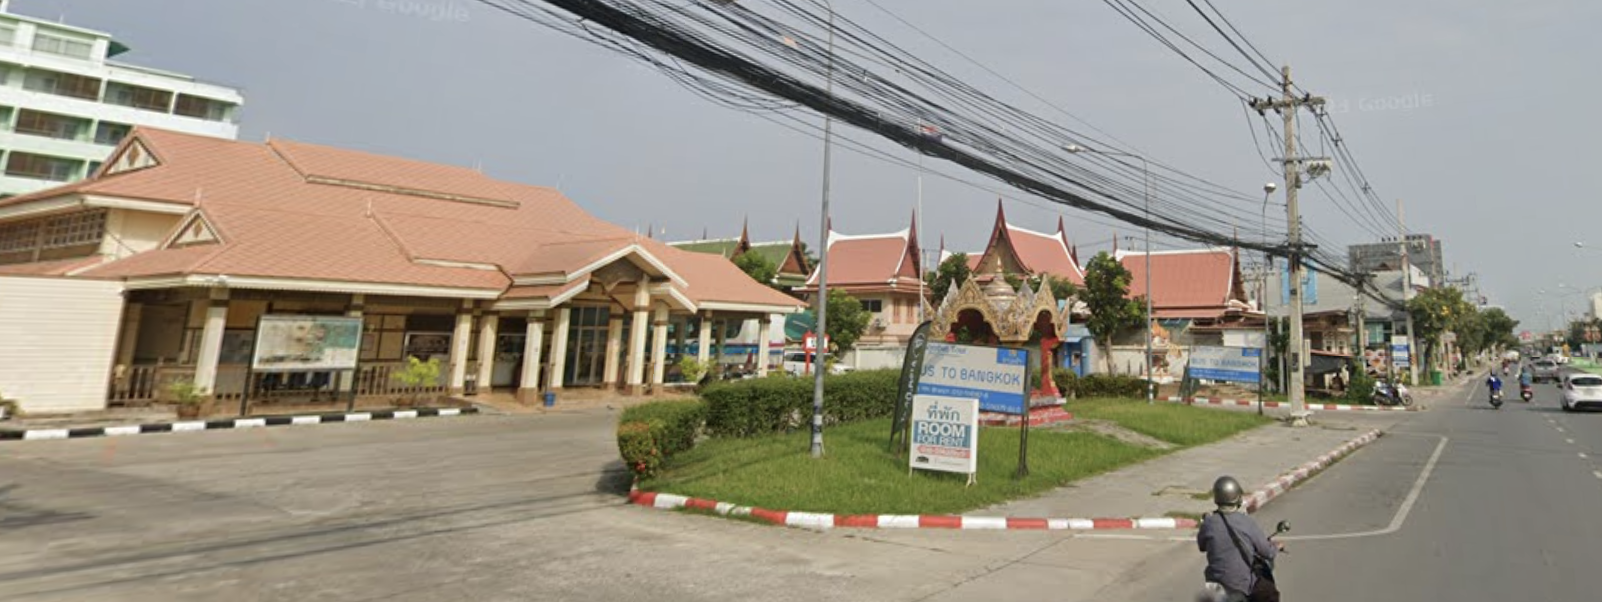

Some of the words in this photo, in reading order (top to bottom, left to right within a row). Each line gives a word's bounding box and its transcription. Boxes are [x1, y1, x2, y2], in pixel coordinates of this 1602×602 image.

[920, 364, 935, 377] US
[942, 366, 957, 379] TO
[961, 368, 1020, 385] BANGKOK
[927, 401, 961, 421] ที่พัก
[918, 421, 965, 437] ROOM
[918, 435, 937, 444] FOR
[940, 438, 963, 447] RENT
